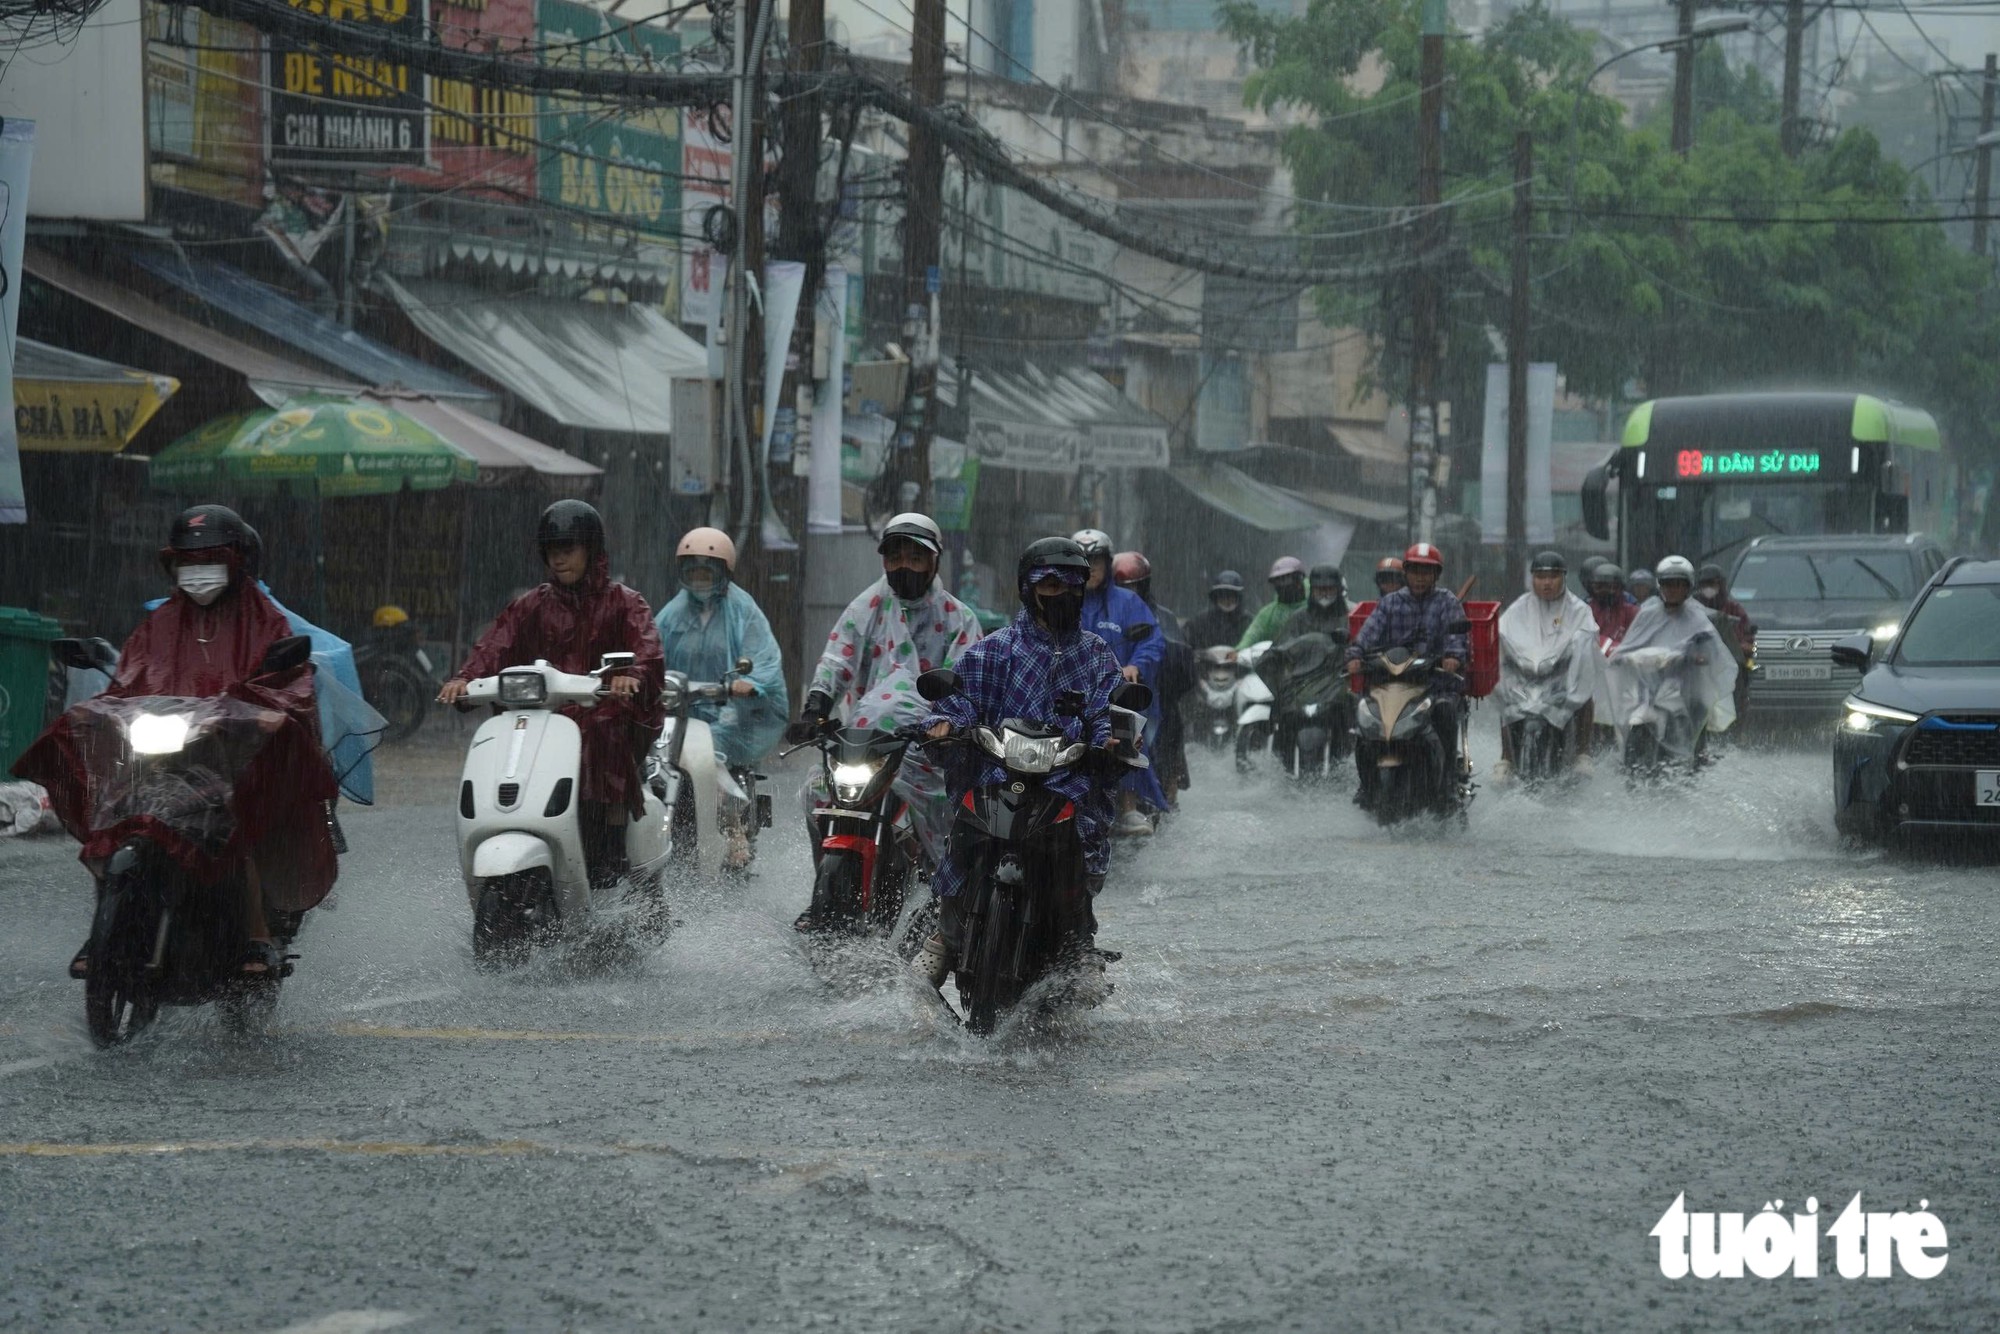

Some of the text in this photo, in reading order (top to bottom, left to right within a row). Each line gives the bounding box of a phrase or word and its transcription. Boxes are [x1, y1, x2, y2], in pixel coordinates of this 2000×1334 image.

[284, 109, 412, 150] CHI NHÁNH 6
[72, 396, 107, 437] HÀ
[1718, 452, 1755, 473] DÂN
